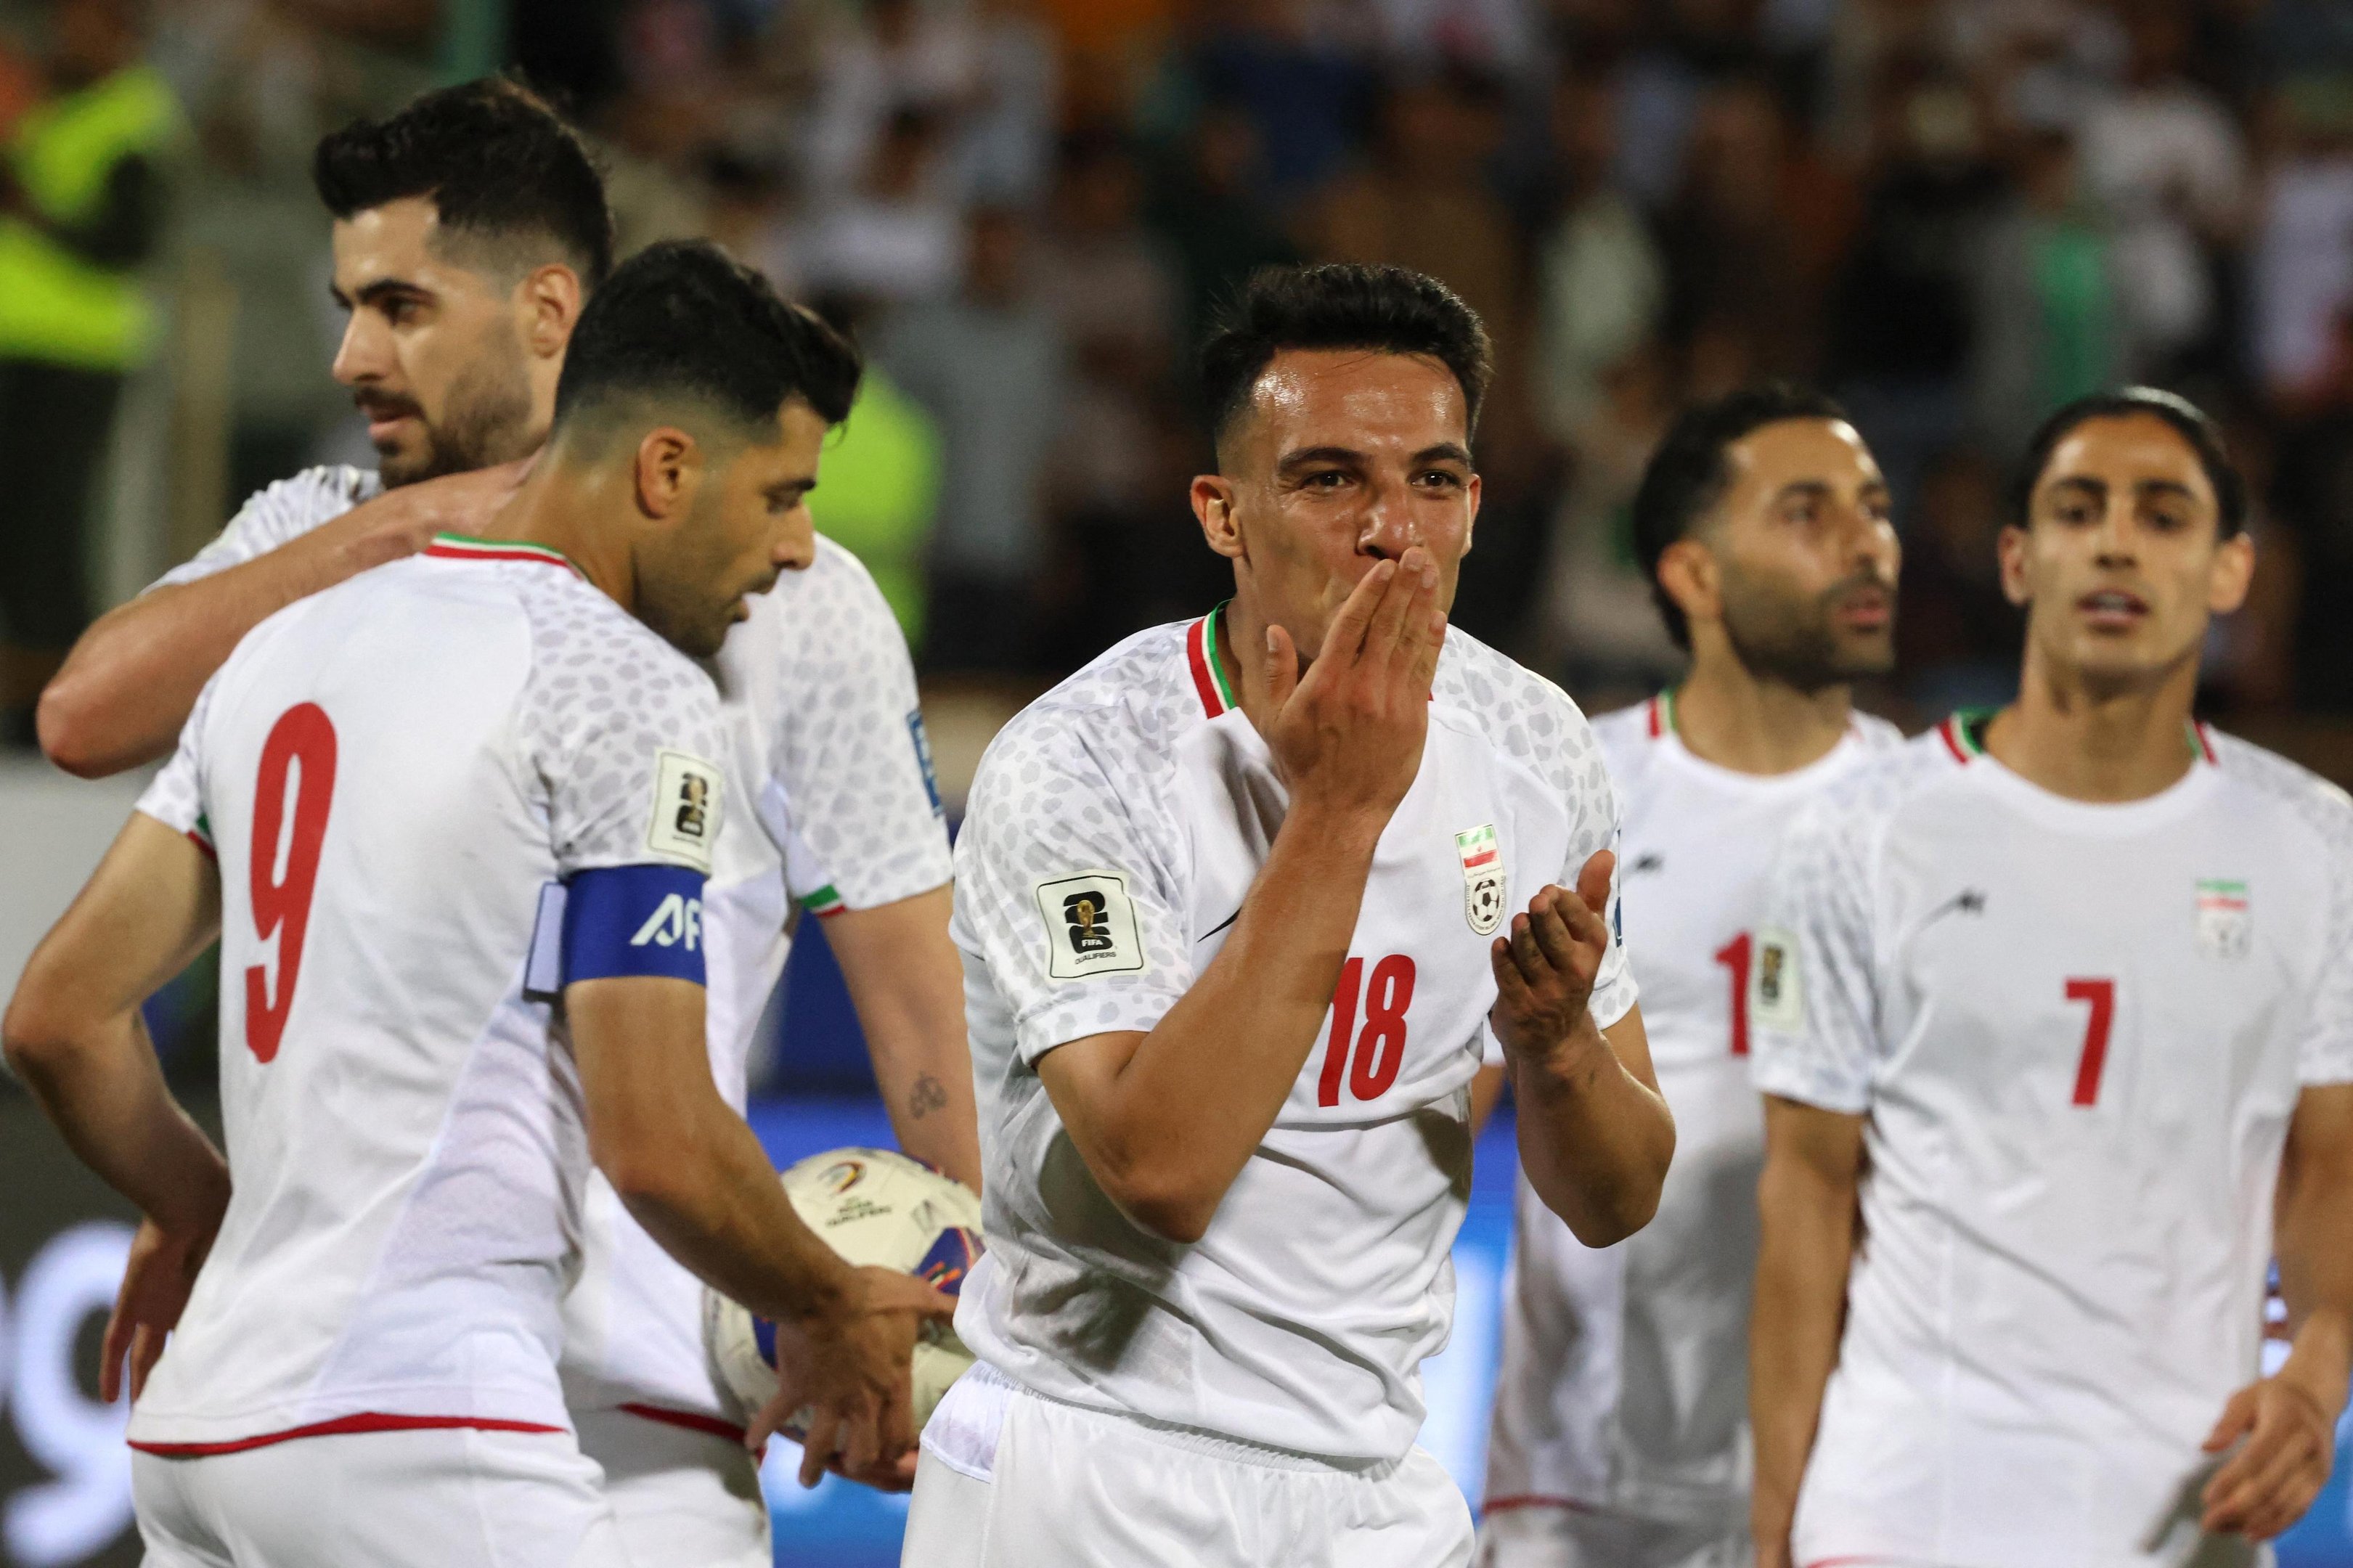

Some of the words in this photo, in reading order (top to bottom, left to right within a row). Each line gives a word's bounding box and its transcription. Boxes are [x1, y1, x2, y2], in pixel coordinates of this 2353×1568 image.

[245, 702, 338, 1063] 9
[1081, 939, 1104, 947] FIFA
[1074, 952, 1117, 965] QUALIFIERS
[1318, 954, 1416, 1108] 18
[2065, 978, 2115, 1107] 7
